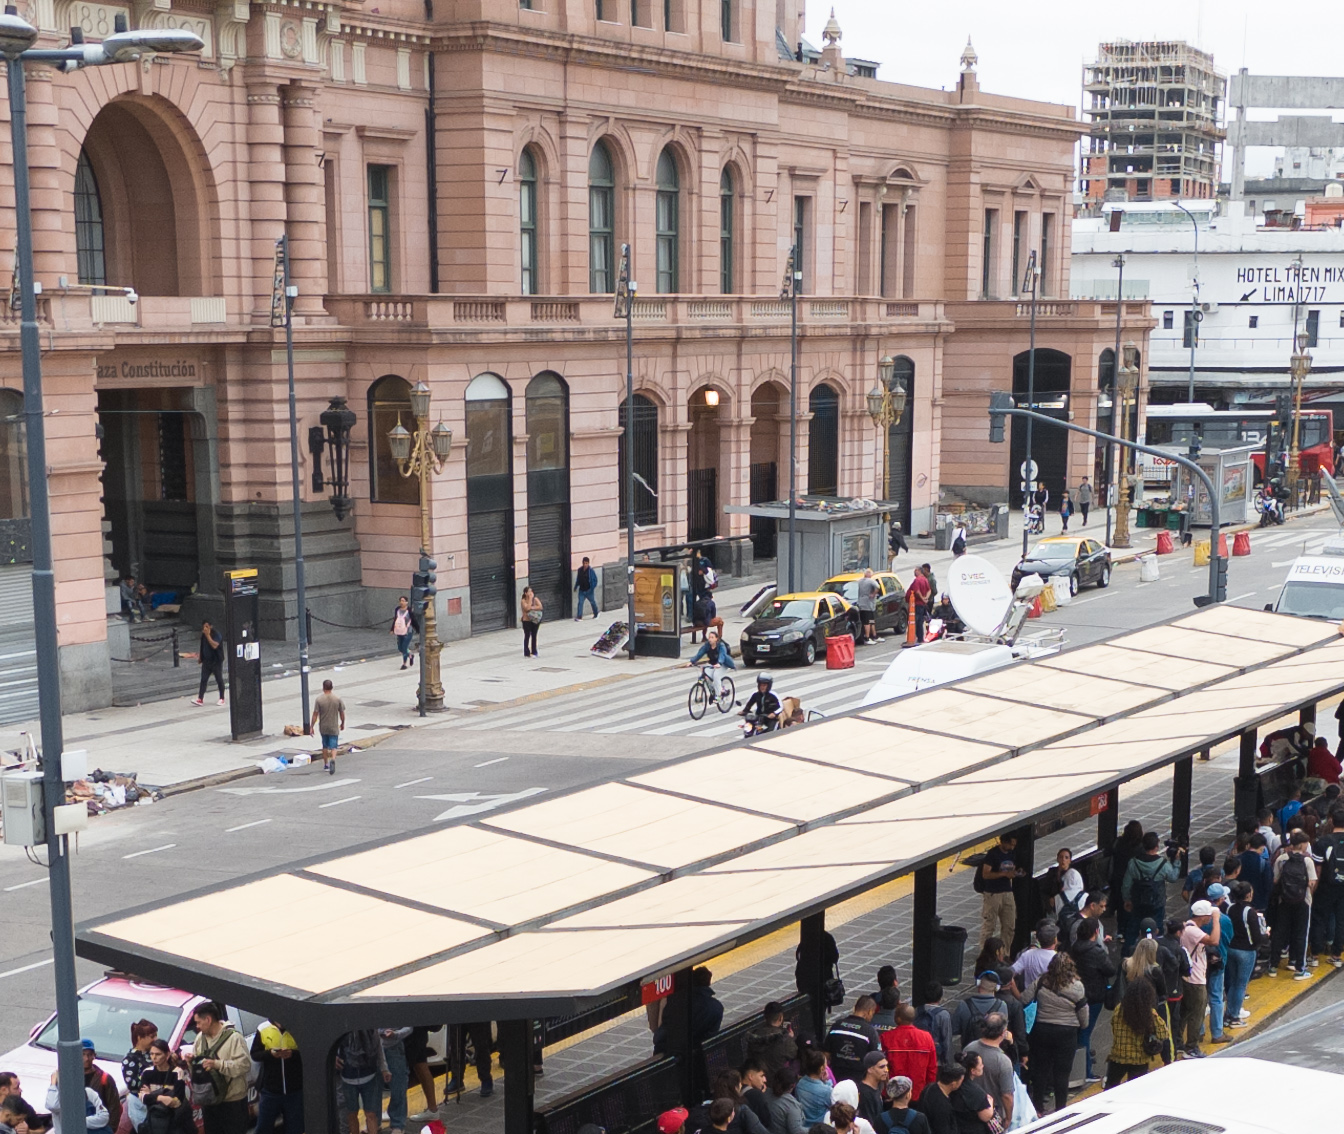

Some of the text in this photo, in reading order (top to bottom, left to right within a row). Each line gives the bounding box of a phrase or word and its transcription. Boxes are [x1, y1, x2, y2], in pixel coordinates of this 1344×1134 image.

[1237, 267, 1282, 283] HOTEL
[1285, 267, 1321, 282] TREN
[1263, 286, 1327, 302] LIMA 1717
[97, 360, 196, 379] aza Constitución
[654, 973, 673, 996] 100
